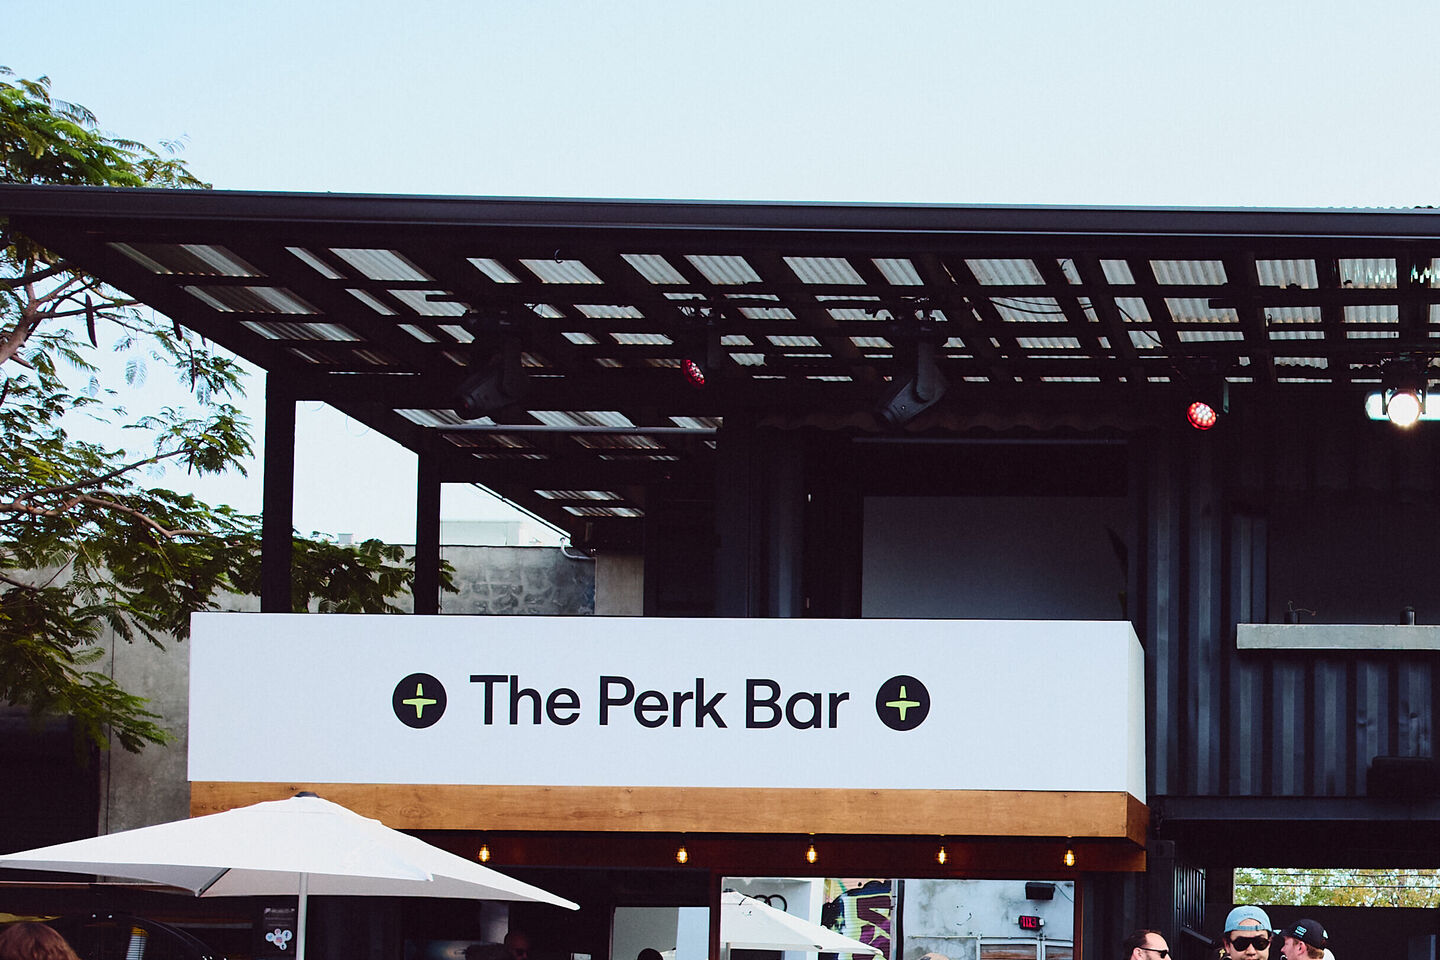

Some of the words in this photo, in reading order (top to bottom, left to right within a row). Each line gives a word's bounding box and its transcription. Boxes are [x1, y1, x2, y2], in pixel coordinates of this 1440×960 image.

[469, 674, 581, 726] The
[599, 675, 728, 729] Perk
[745, 678, 850, 730] Bar
